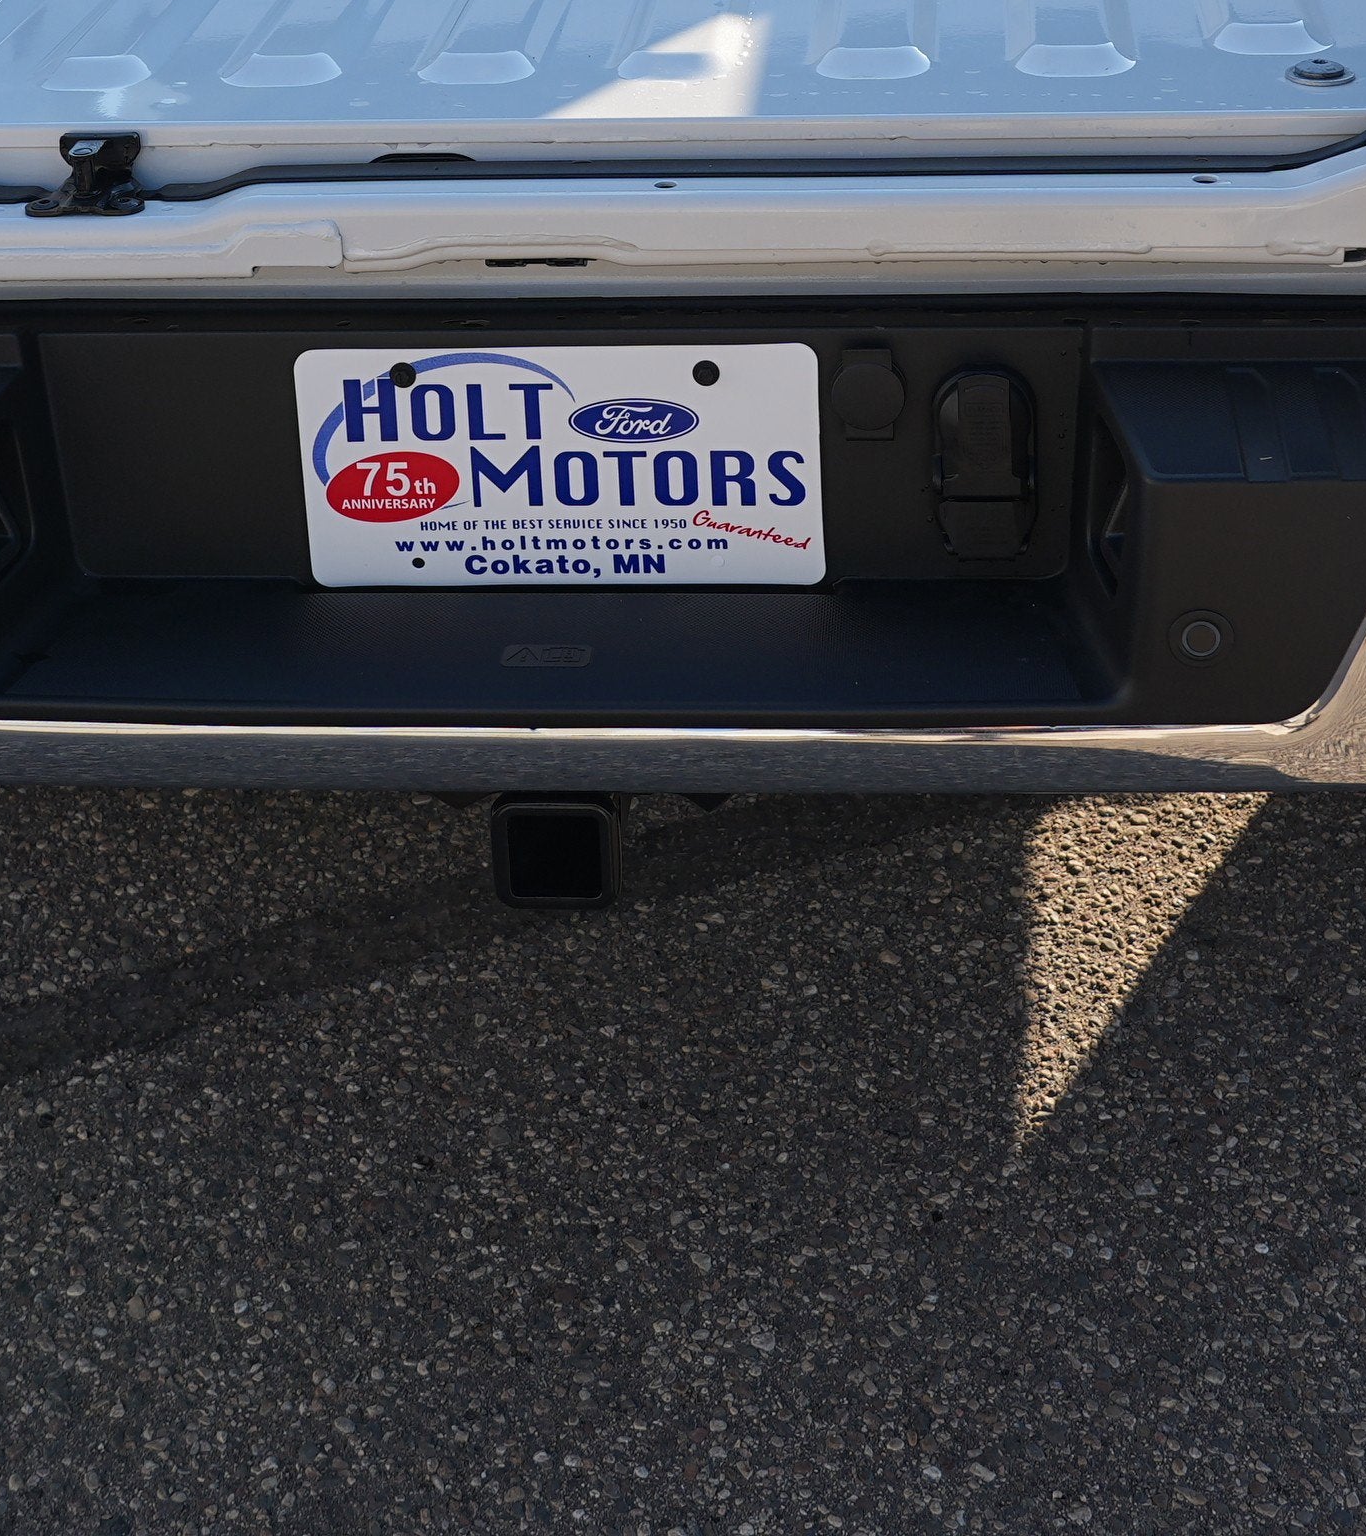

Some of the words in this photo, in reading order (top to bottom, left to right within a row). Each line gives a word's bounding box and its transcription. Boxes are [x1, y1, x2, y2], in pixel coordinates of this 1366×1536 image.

[342, 376, 554, 443] HOLT
[594, 404, 672, 436] Ford
[356, 461, 436, 497] 75th
[469, 444, 807, 508] MOTORS
[341, 498, 436, 511] ANNIVERSARY
[420, 520, 458, 531] HOME
[463, 520, 479, 530] OF
[485, 519, 507, 530] THE
[512, 519, 544, 530] BEST
[548, 518, 603, 530] SERVICE
[608, 518, 648, 529] SINCE
[653, 518, 687, 529] 1950
[692, 509, 812, 551] Guaranteed
[395, 535, 729, 552] www.holtmotors.com
[464, 554, 602, 578] Cokato,
[613, 554, 666, 574] MN
